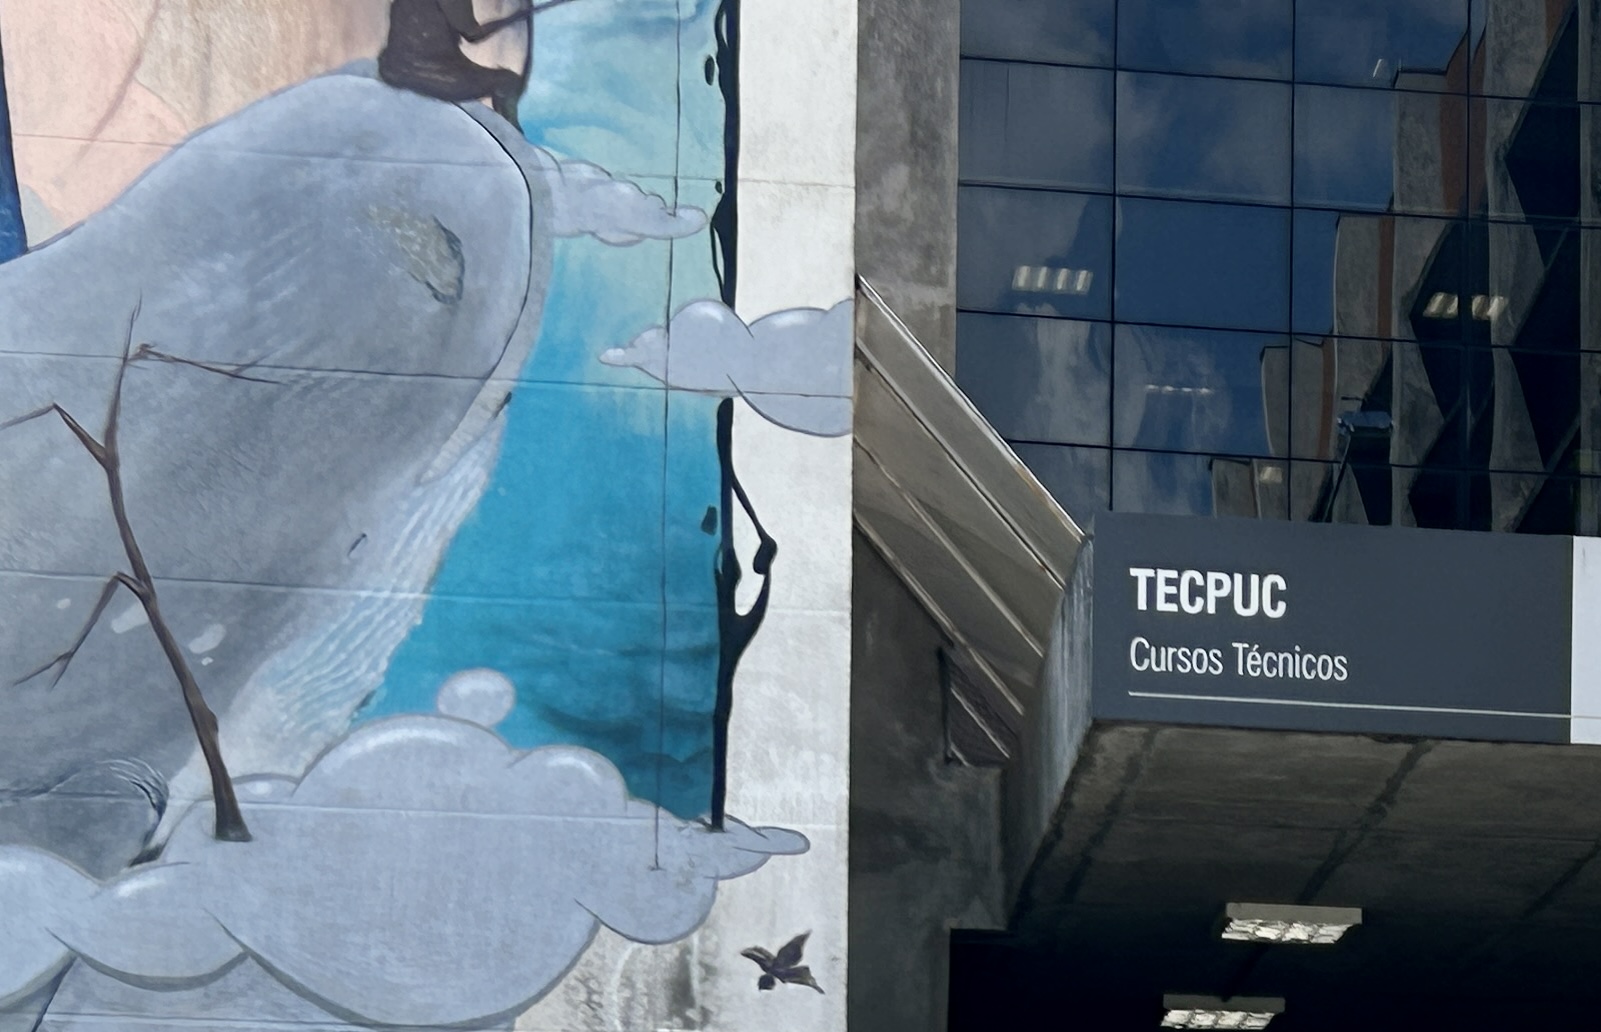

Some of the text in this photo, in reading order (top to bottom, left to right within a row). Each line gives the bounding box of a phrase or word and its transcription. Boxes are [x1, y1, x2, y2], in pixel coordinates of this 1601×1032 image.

[1129, 567, 1287, 619] TECPUC
[1129, 636, 1348, 682] Cursos Técnicos
